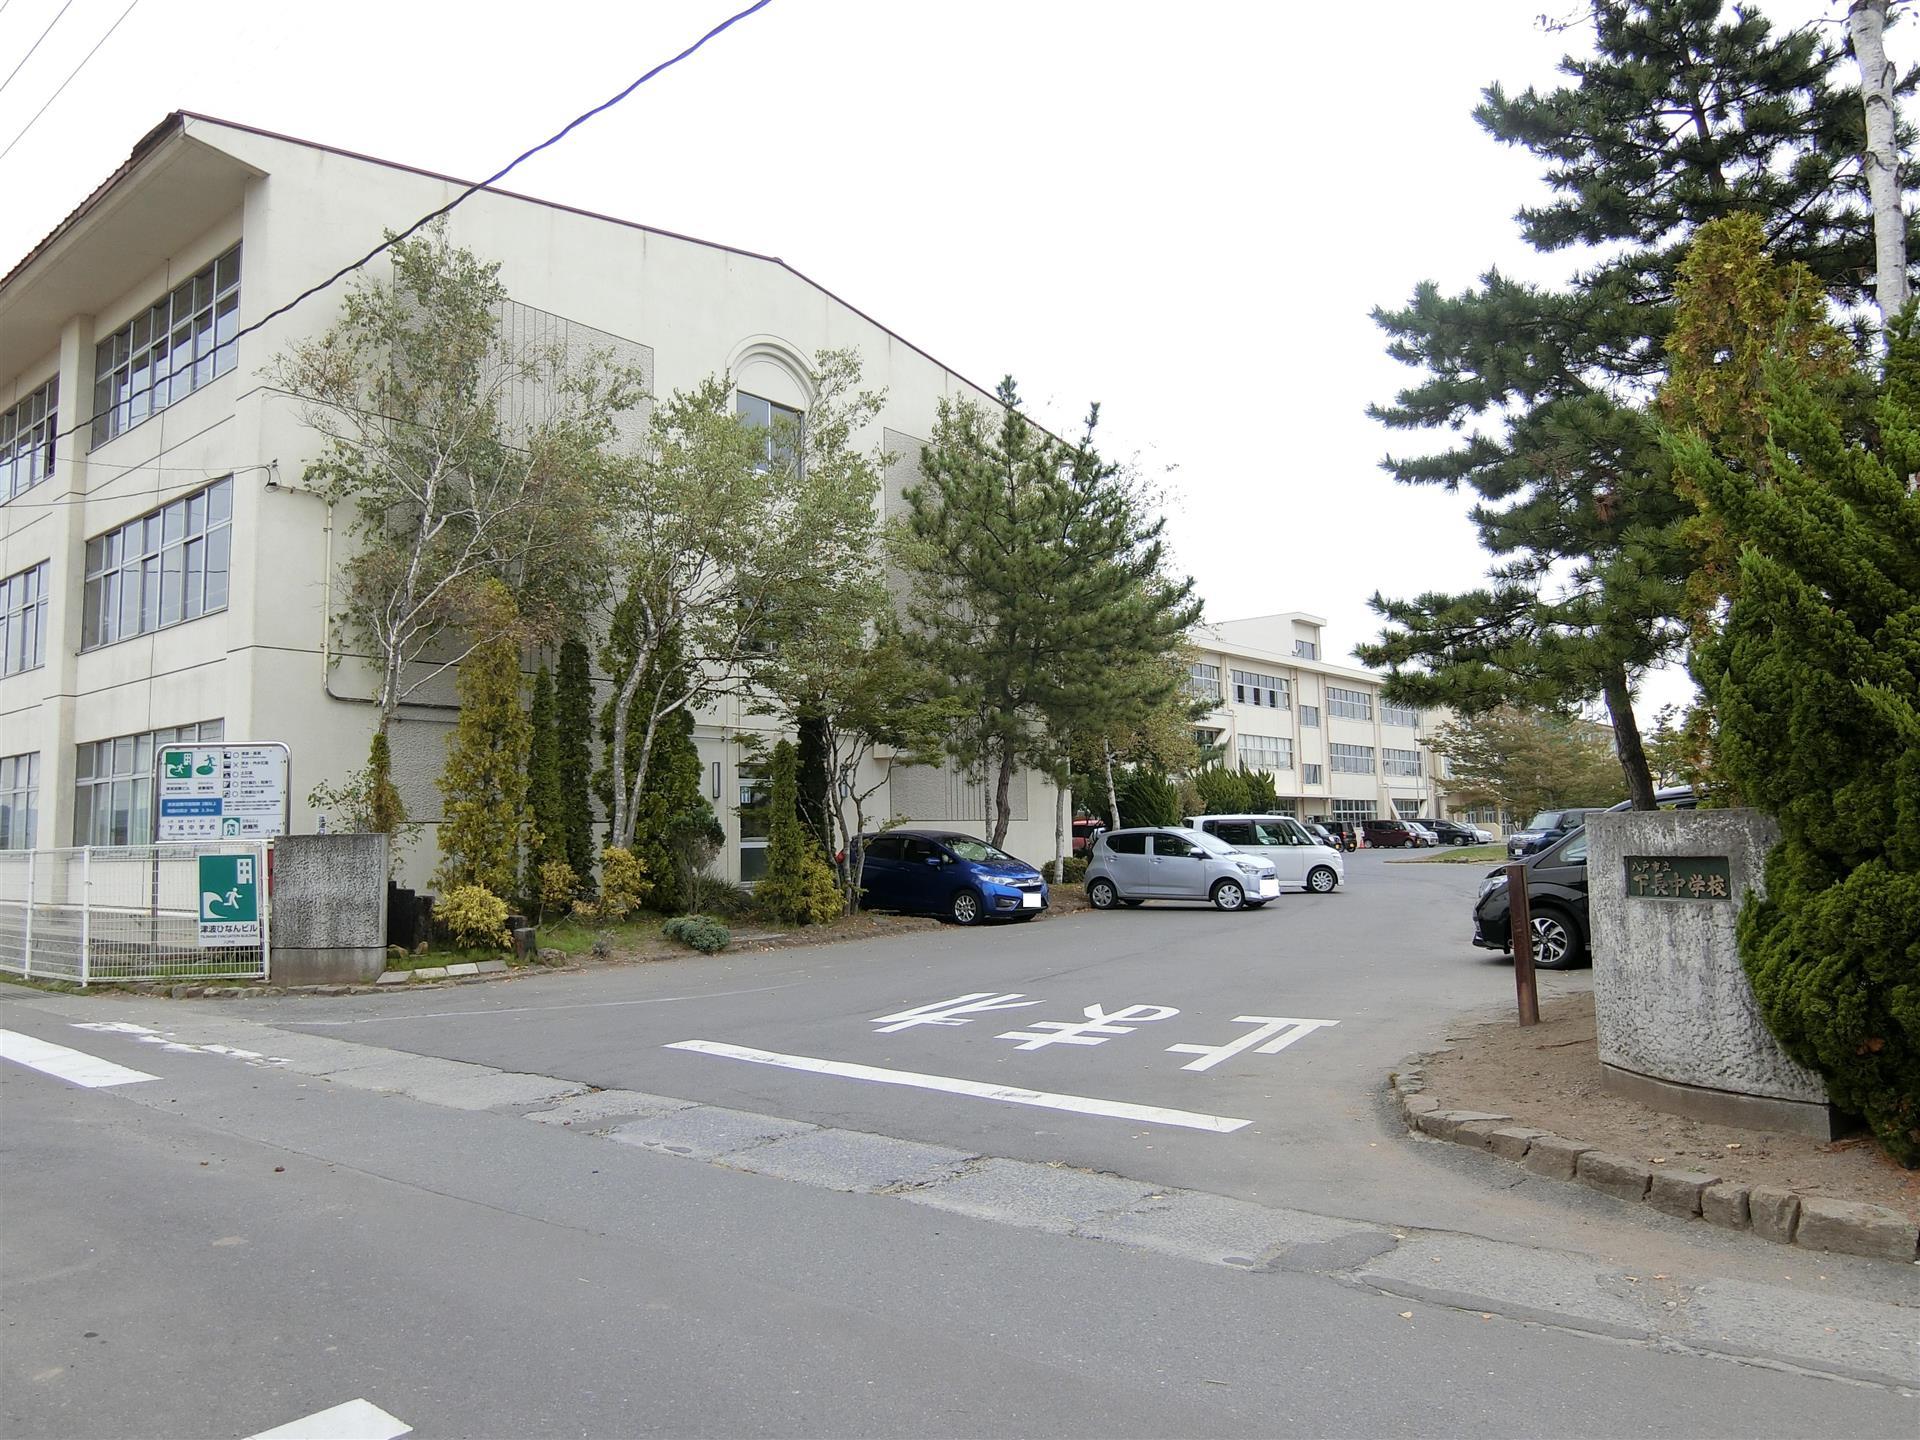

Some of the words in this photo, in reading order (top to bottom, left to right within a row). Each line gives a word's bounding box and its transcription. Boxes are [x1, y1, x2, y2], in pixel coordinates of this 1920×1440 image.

[1631, 860, 1672, 873] 八戸市立
[1632, 872, 1728, 898] 下長中学校
[200, 924, 258, 933] 津波ひなんビル
[869, 992, 1340, 1072] 止まれ
